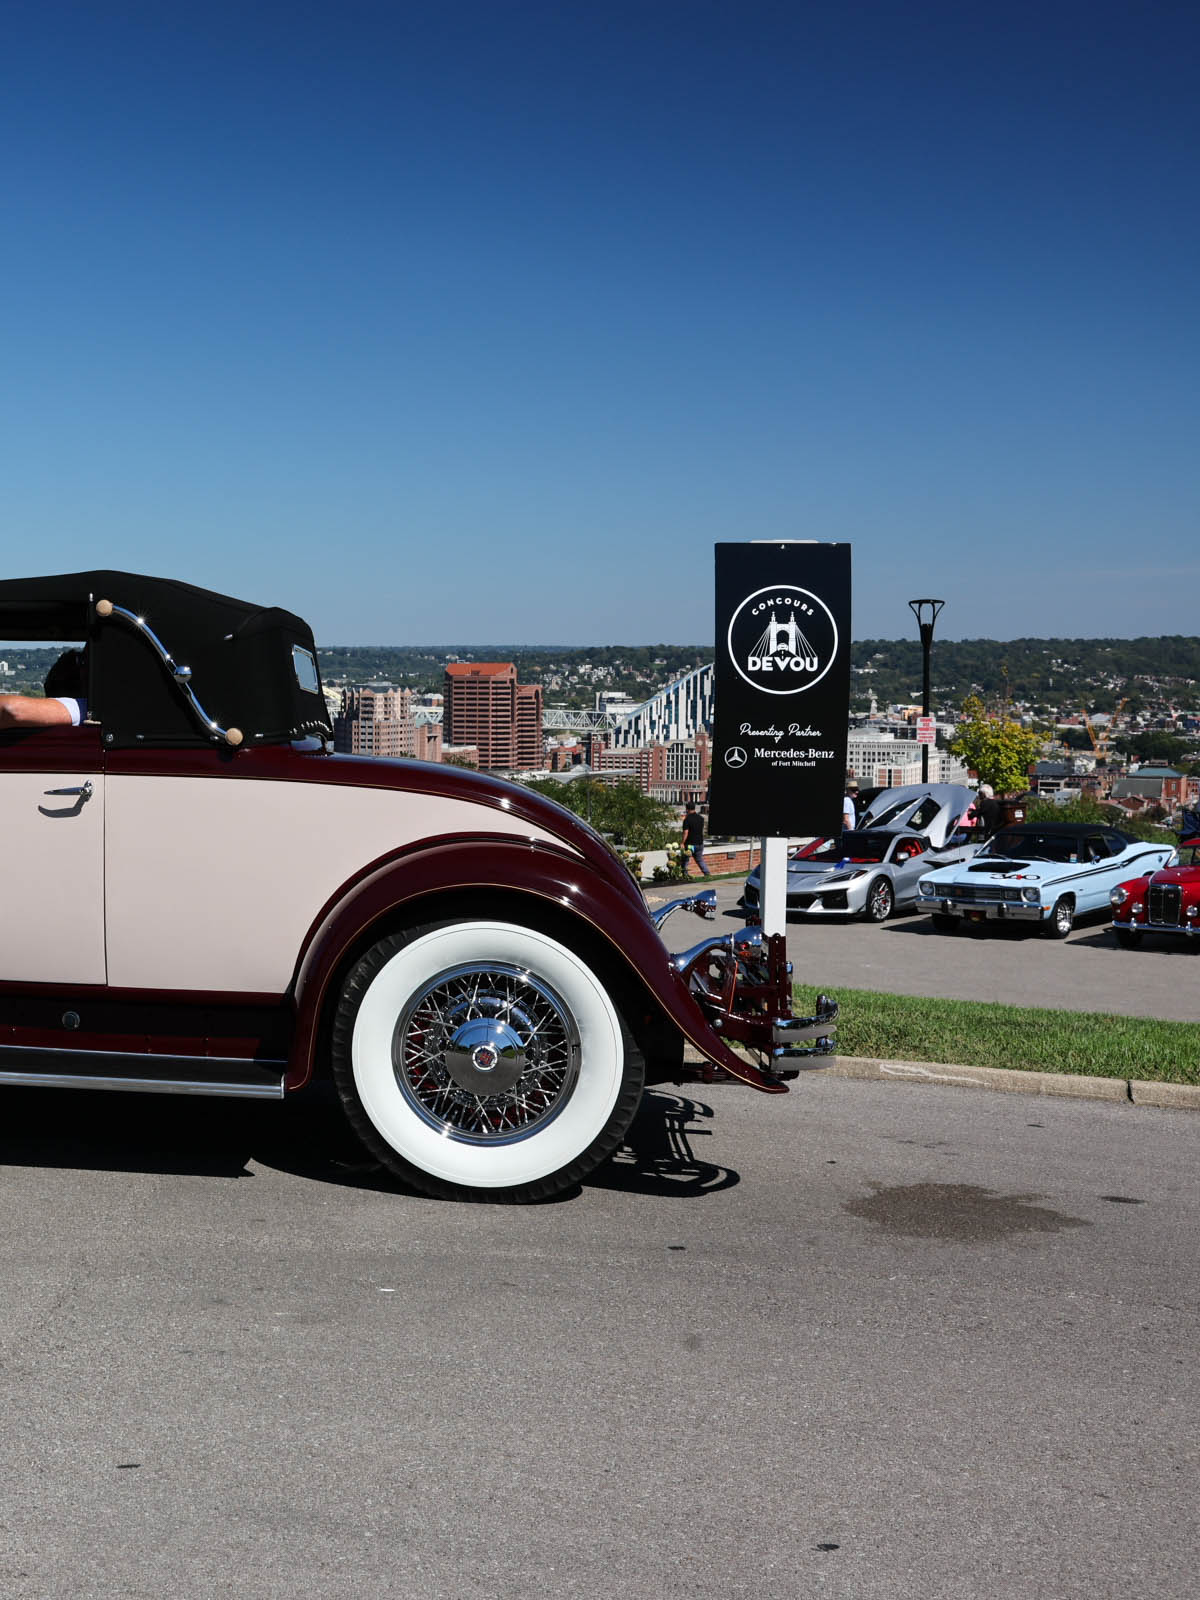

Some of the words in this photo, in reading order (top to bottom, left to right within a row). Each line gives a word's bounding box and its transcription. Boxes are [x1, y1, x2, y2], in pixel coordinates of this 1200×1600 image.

[752, 597, 814, 616] CONCOURS
[747, 656, 818, 672] DEVOU
[739, 722, 785, 744] Presenting
[788, 722, 822, 737] Partner
[754, 747, 835, 759] Mercedes-Benz
[990, 873, 1041, 881] 340
